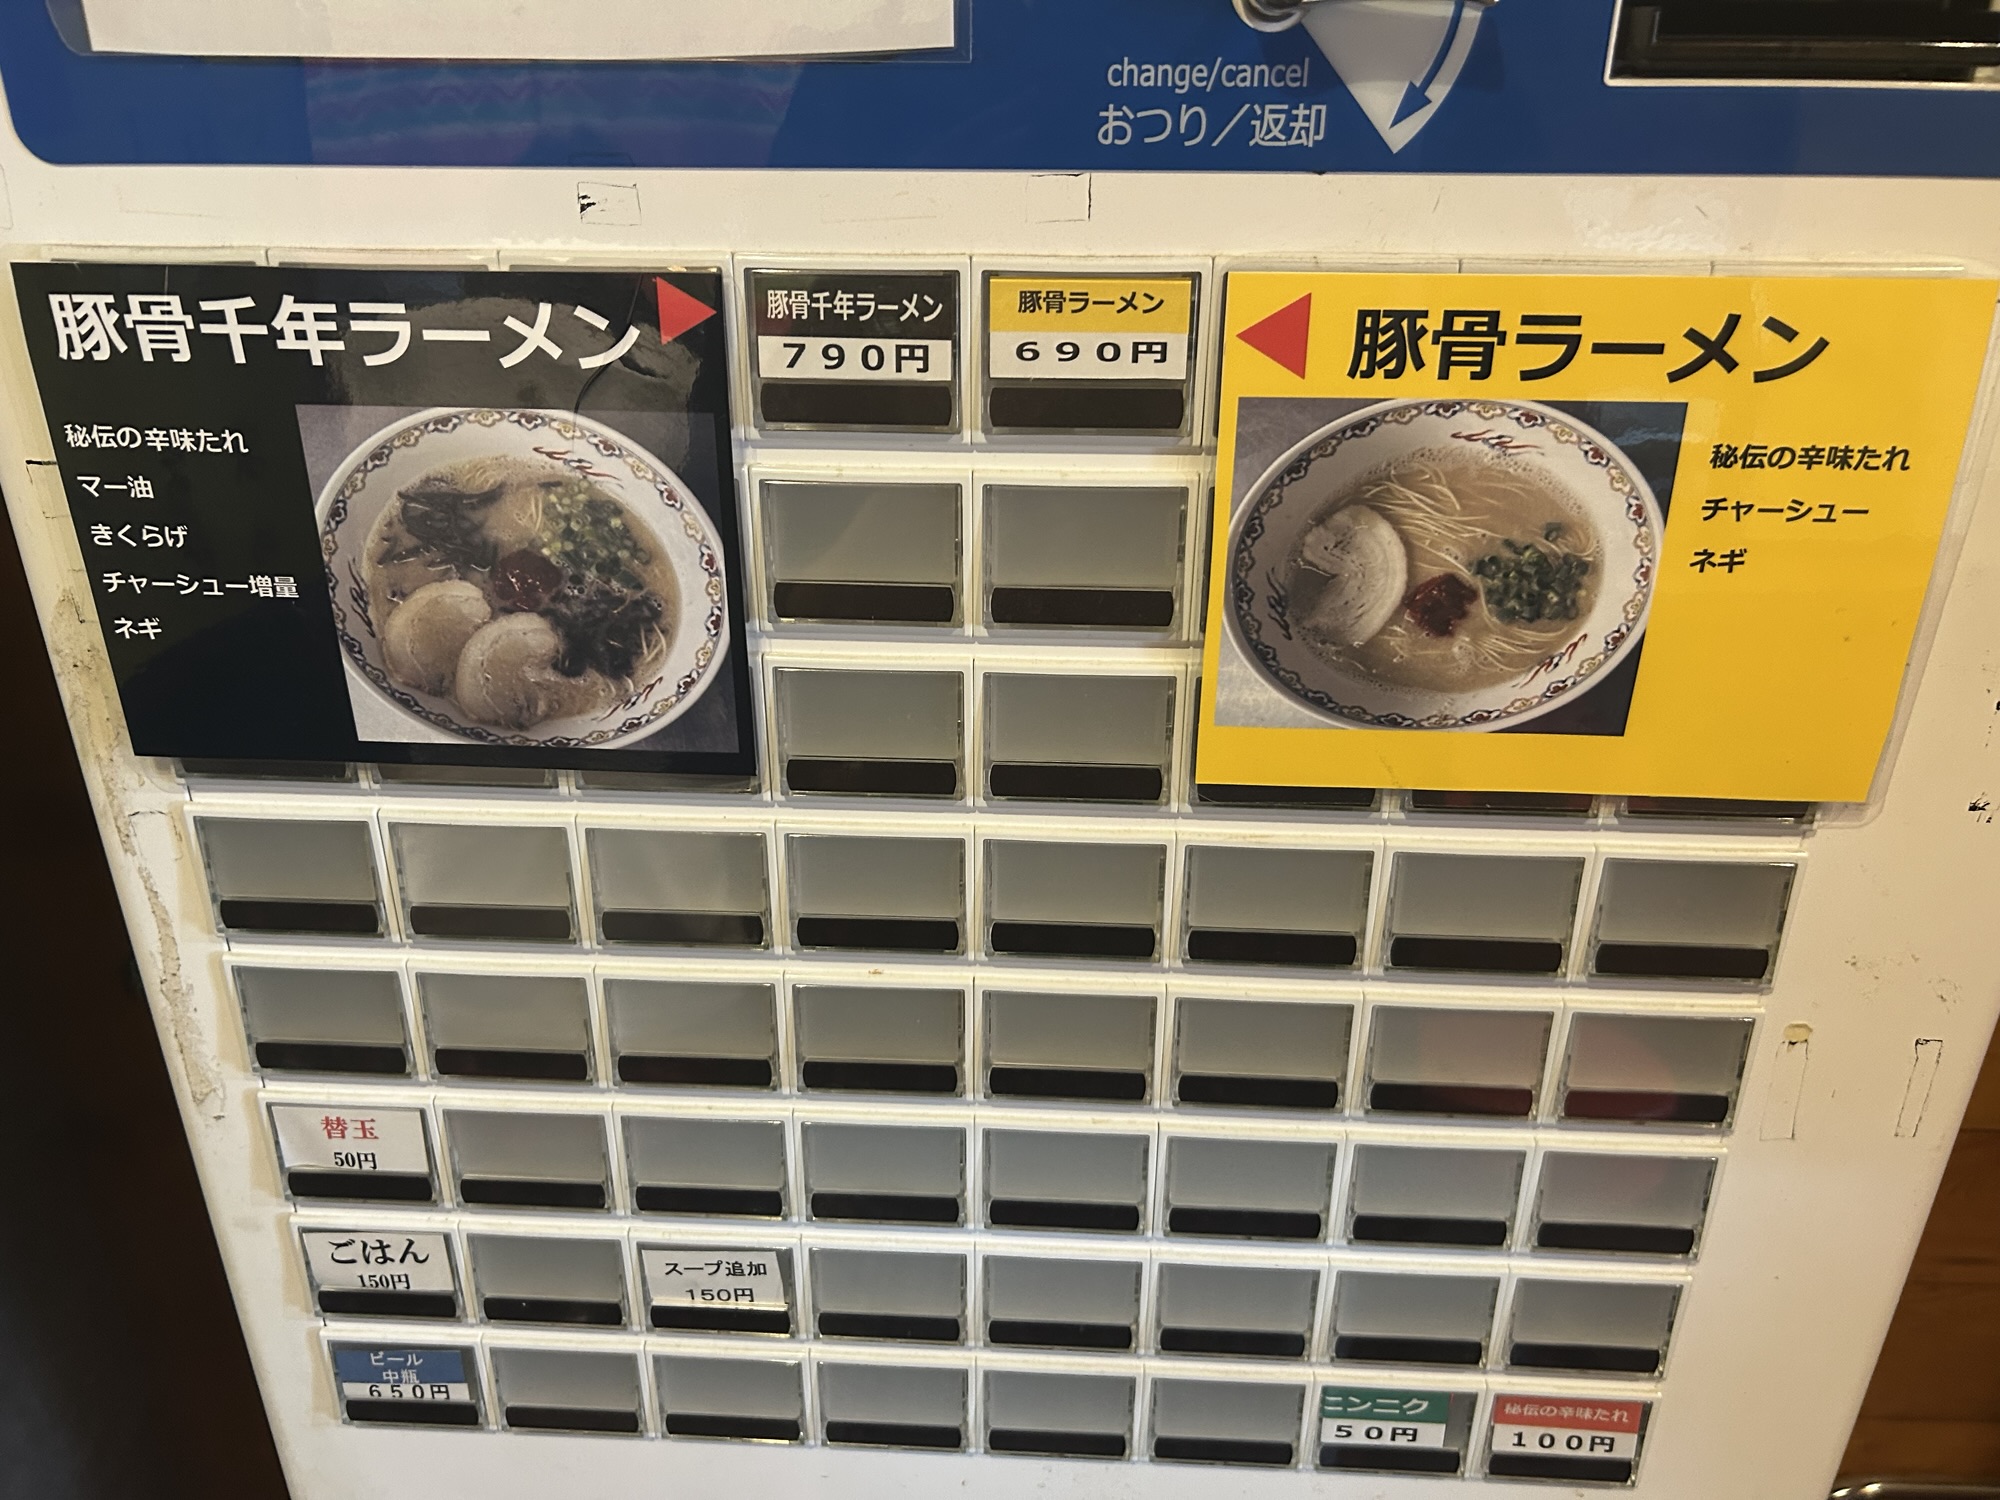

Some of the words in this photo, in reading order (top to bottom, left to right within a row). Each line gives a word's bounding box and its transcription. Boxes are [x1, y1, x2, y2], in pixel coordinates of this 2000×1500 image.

[1107, 57, 1309, 92] change/cancel
[1098, 104, 1326, 148] おつり／返却
[767, 290, 943, 323] 豚骨千年ラーメン
[1018, 290, 1164, 315] 豚骨ラーメン
[49, 294, 639, 370] 豚骨千年ラーメン
[782, 343, 929, 373] 790円
[1016, 341, 1168, 364] 690円
[1347, 309, 1830, 383] 豚骨ラーメン
[65, 424, 249, 454] 秘伝の辛味たれ
[1709, 444, 1911, 472] 秘伝の辛味たれ
[76, 475, 154, 499] マー油
[1701, 498, 1869, 522] チャーシュー
[91, 522, 187, 549] きくらげ
[1689, 548, 1747, 573] ネギ
[102, 572, 300, 600] チャーシュー増量
[114, 617, 162, 640] ネギ
[320, 1116, 379, 1141] 替玉
[333, 1151, 378, 1171] 50円
[329, 1239, 429, 1266] ごはん
[357, 1271, 411, 1290] 150円
[664, 1260, 767, 1277] スープ追加
[685, 1287, 755, 1303] 150円
[370, 1351, 423, 1367] ビール
[382, 1368, 419, 1384] 中瓶
[367, 1385, 450, 1401] 650円
[1322, 1396, 1430, 1415] ニンニク
[1504, 1401, 1629, 1423] 秘伝の辛味たれ
[1334, 1424, 1418, 1442] 50円
[1511, 1431, 1616, 1454] 100円
